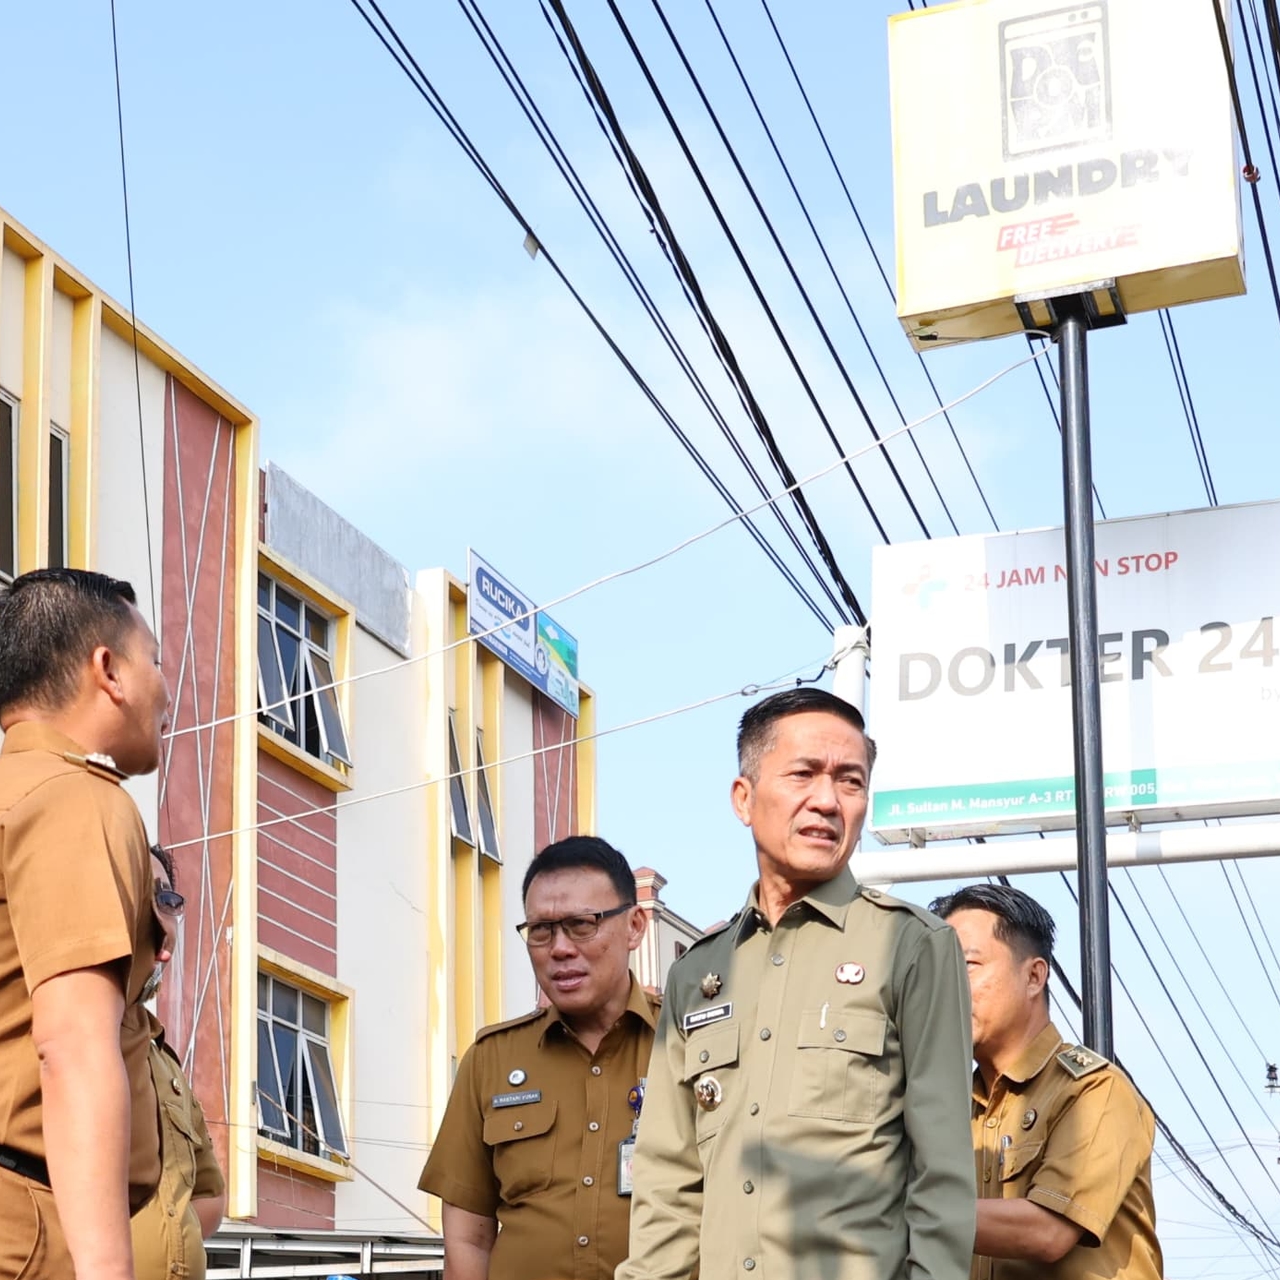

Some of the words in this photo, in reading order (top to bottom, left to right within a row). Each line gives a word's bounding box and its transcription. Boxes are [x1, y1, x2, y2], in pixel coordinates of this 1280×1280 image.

[922, 148, 1194, 228] LAUNDRY
[1000, 218, 1055, 249] FREE
[997, 566, 1045, 588] JAM
[1054, 559, 1110, 582] NN
[1117, 551, 1179, 576] STOP
[481, 575, 525, 624] RUCIKA
[1198, 615, 1280, 673] 24
[906, 800, 948, 815] Sultan
[970, 795, 1025, 813] Mansyur
[1028, 792, 1052, 805] A-3
[1055, 789, 1073, 803] RT
